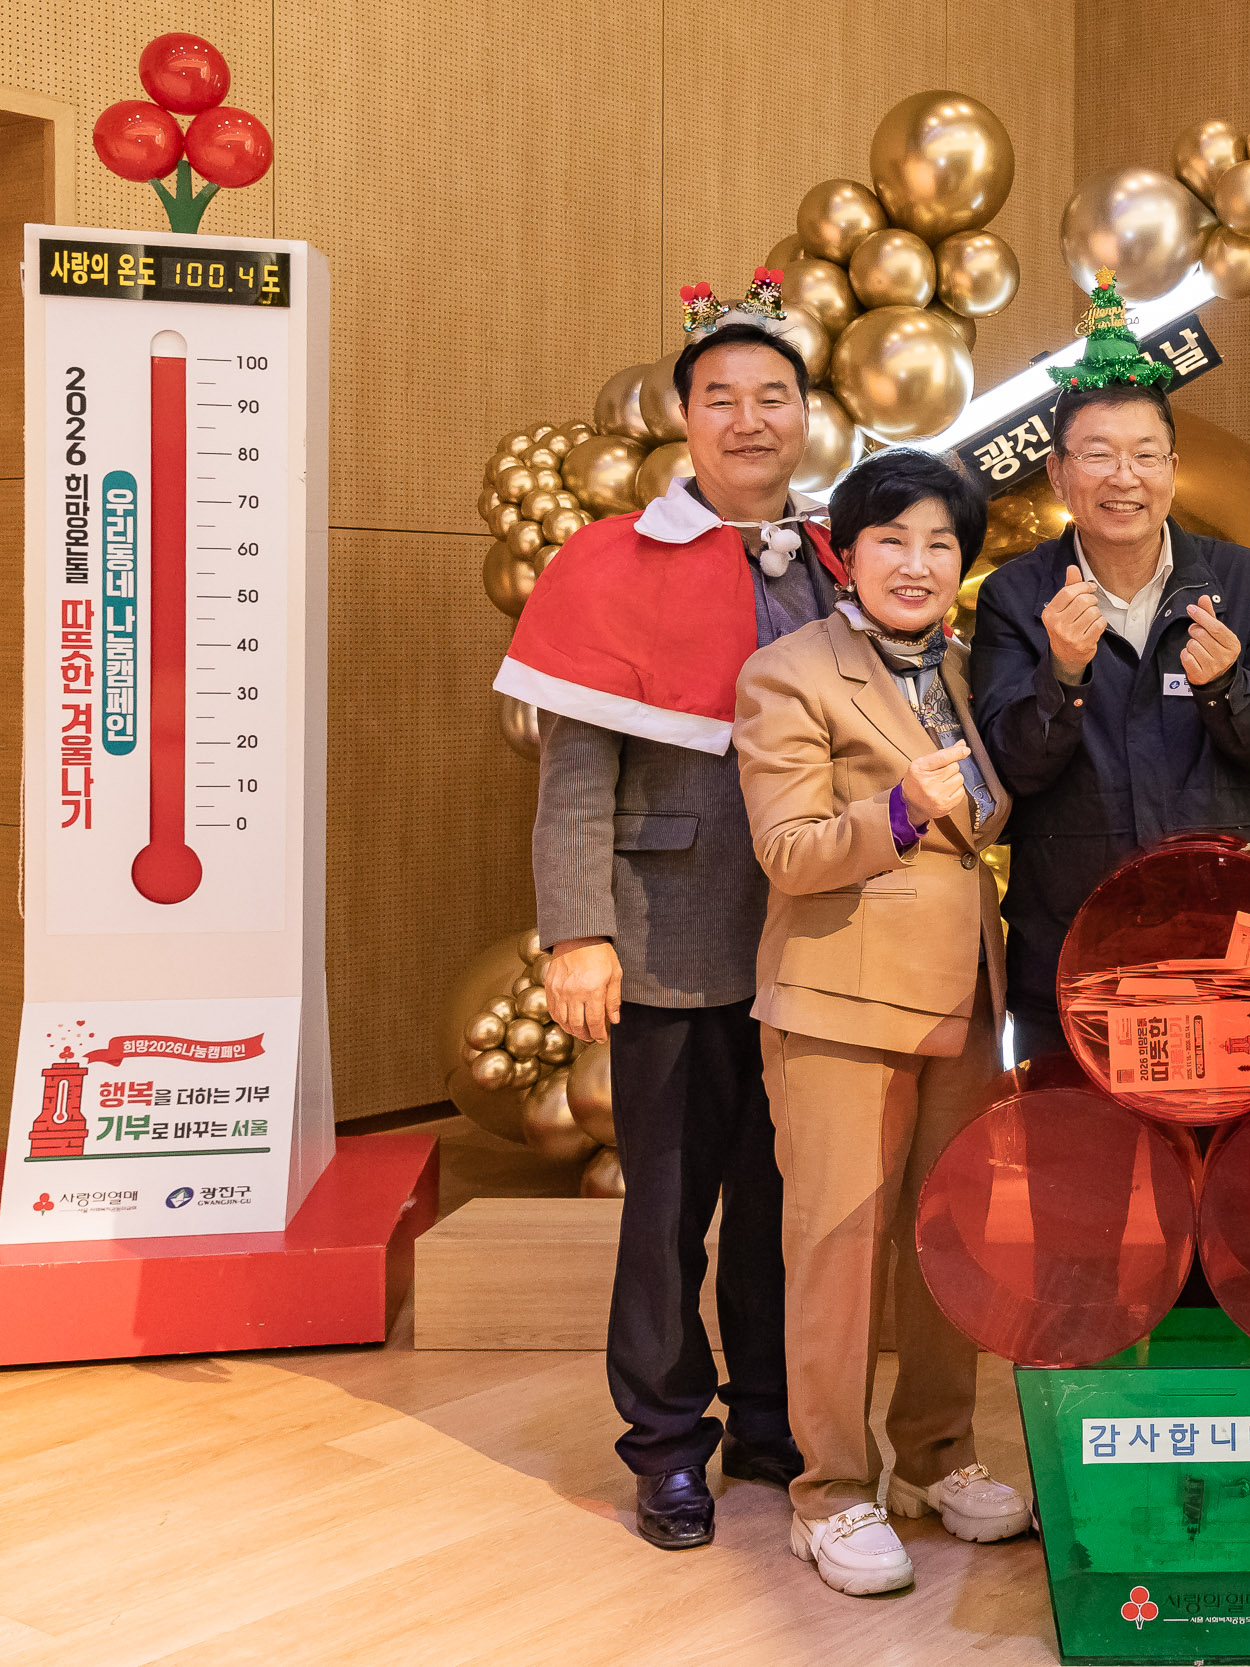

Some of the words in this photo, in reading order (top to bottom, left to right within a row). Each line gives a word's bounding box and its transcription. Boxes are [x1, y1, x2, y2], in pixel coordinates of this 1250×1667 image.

[50, 250, 109, 286] 사랑의
[117, 253, 156, 287] 온도
[1159, 327, 1208, 376] 날
[236, 356, 268, 370] 100
[237, 399, 260, 414] 90
[65, 366, 87, 466] 2026
[238, 447, 259, 461] 80
[238, 495, 259, 509] 70
[65, 473, 90, 584] 희망온돌
[105, 488, 135, 599] 우리동네
[237, 543, 259, 556] 60
[237, 589, 259, 603] 50
[60, 599, 95, 694] 따뜻한
[236, 638, 259, 652] 40
[105, 605, 136, 742] 나눔캠페인
[237, 686, 258, 700] 30
[236, 735, 258, 749] 20
[60, 703, 94, 829] 겨울나기
[237, 779, 258, 793] 10
[236, 817, 247, 830] 0
[122, 1039, 246, 1059] 희망2026나눔캠페인
[1148, 1016, 1169, 1082] 따뜻한
[1140, 1058, 1149, 1081] 2026
[99, 1080, 172, 1109] 행복을
[176, 1088, 230, 1105] 더하는
[234, 1086, 270, 1104] 기부
[96, 1114, 169, 1141] 기부로
[173, 1121, 228, 1139] 바꾸는
[231, 1119, 268, 1137] 서울
[58, 1190, 138, 1207] 사랑의열매
[200, 1185, 252, 1199] 광진구
[197, 1198, 252, 1206] GWANGJIN-GU
